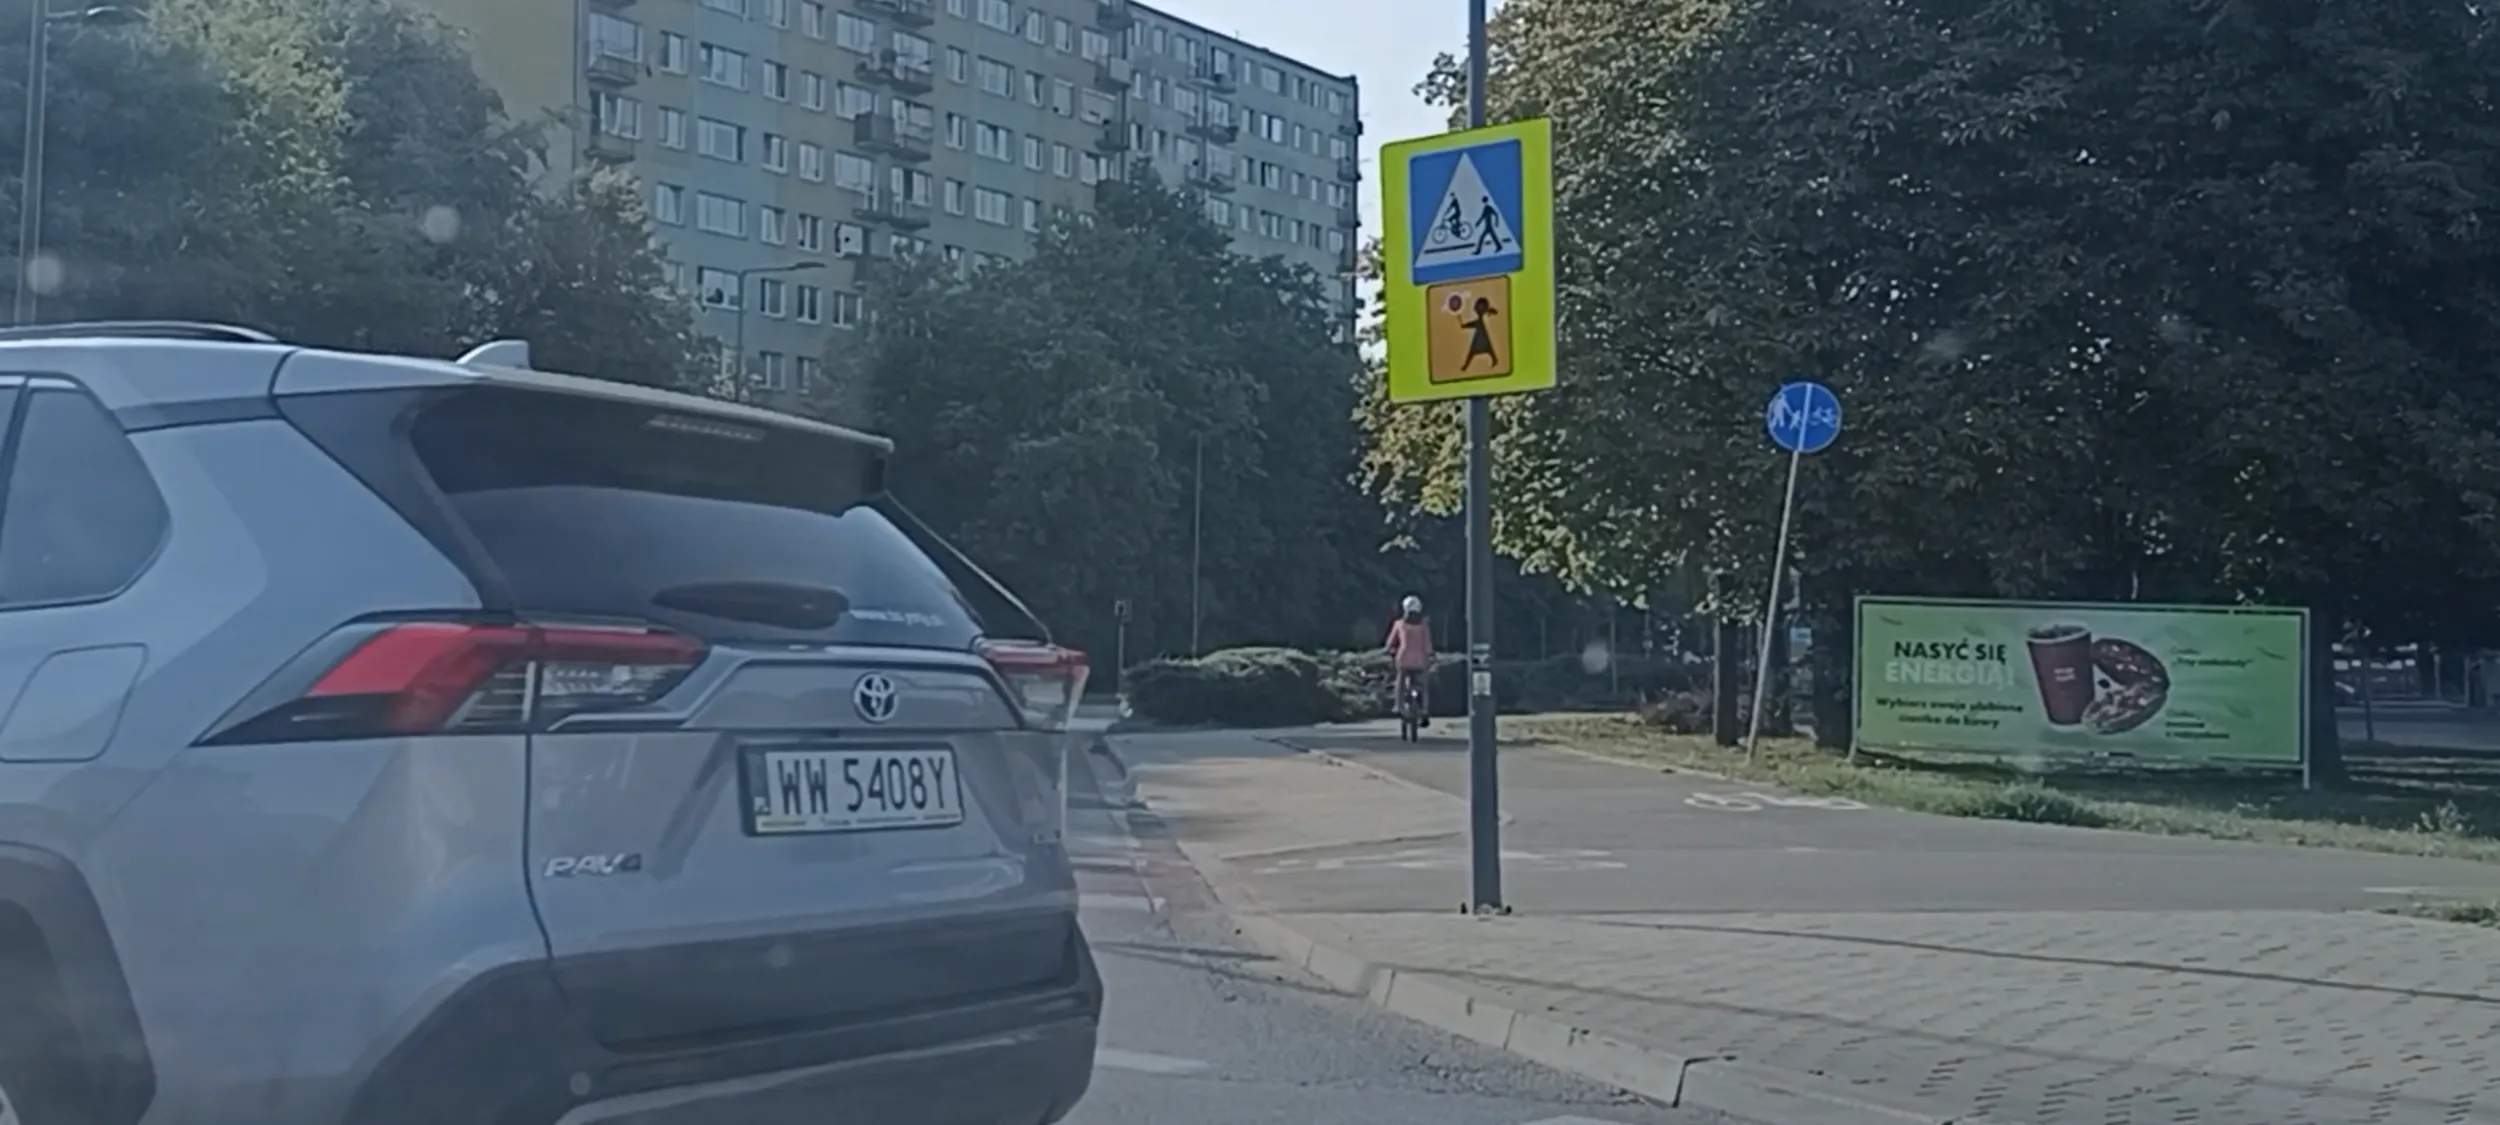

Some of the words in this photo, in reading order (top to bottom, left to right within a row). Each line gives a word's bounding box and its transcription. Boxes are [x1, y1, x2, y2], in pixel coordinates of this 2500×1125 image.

[1894, 638, 1969, 660] NASYĆ
[1975, 643, 2007, 666] SIĘ
[1885, 660, 2014, 691] ENERGIĄ!
[777, 757, 828, 815] WW
[844, 756, 945, 812] 5408Y
